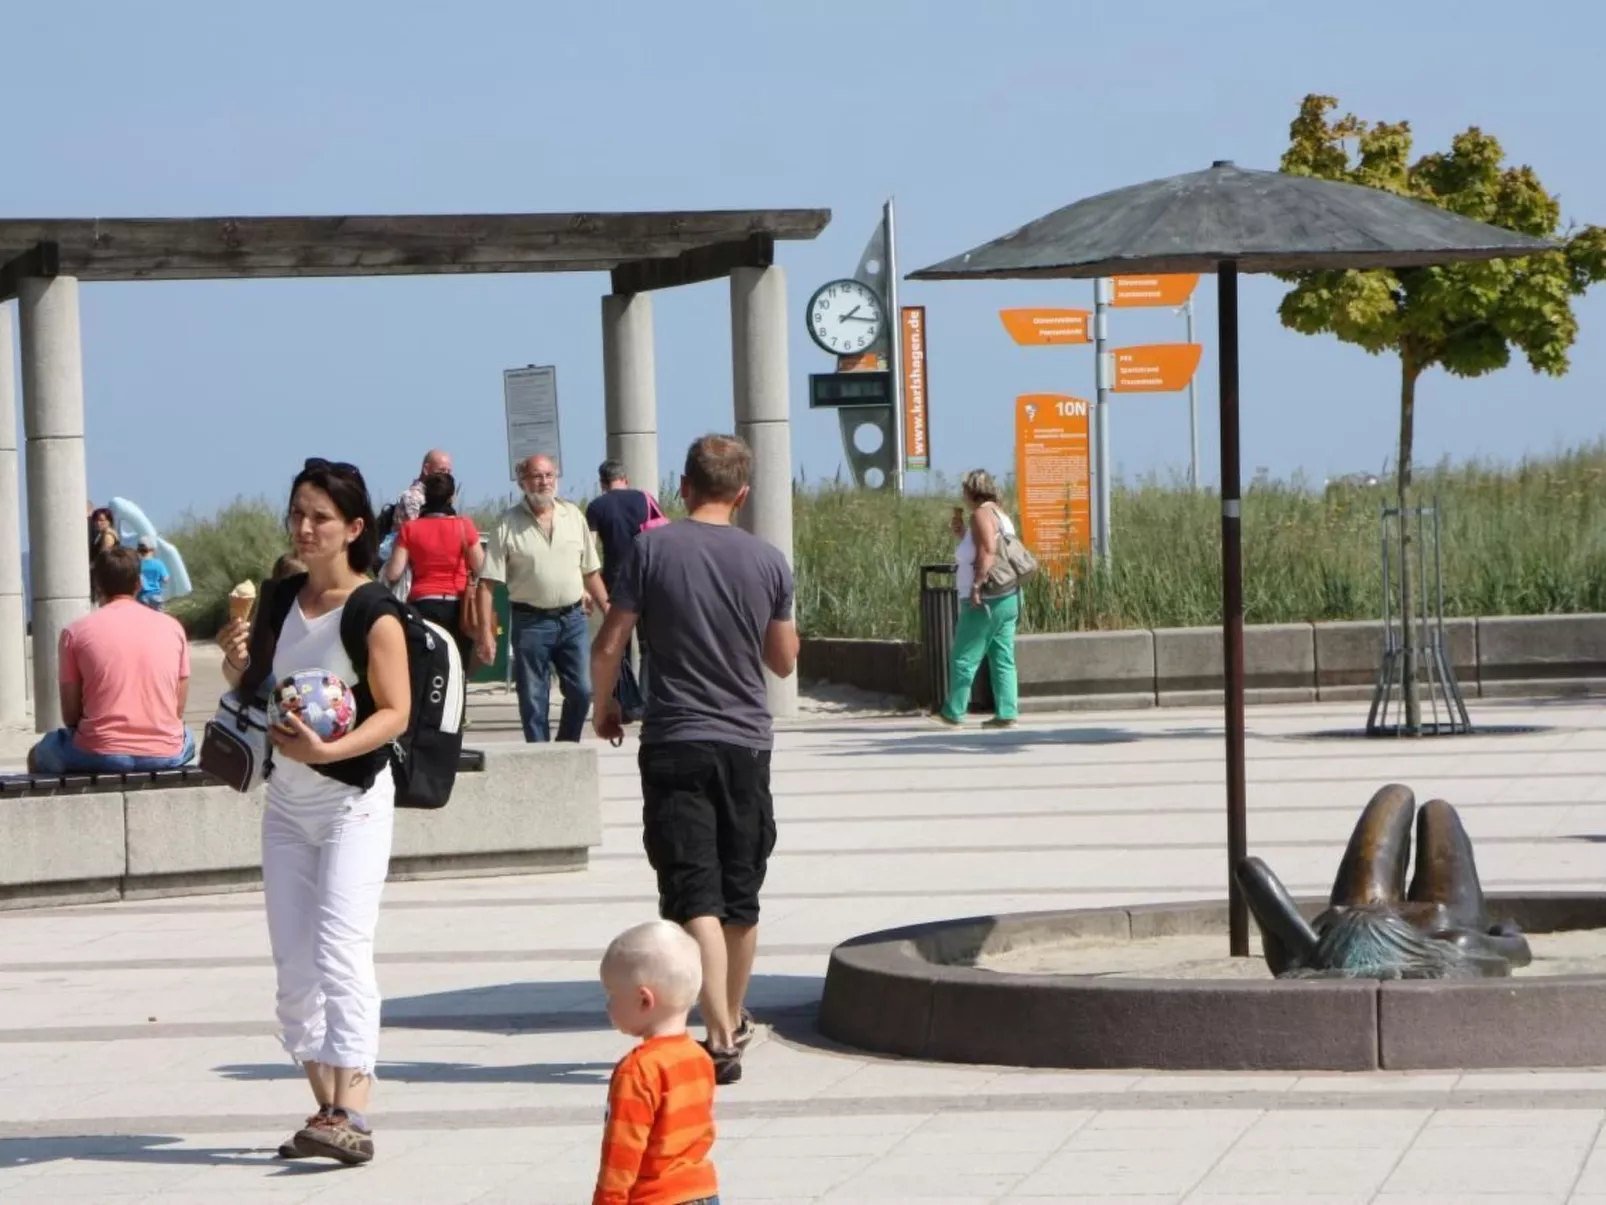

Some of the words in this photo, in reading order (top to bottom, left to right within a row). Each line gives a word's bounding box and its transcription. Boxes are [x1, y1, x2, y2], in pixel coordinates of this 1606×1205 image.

[828, 288, 836, 298] 11
[840, 283, 851, 293] 12
[818, 299, 830, 310] 10
[867, 297, 875, 307] 2
[814, 313, 822, 323] 9
[819, 327, 827, 337] 8
[867, 326, 875, 335] 4
[831, 337, 838, 347] 7
[844, 340, 852, 350] 6
[857, 336, 865, 346] 5
[907, 310, 925, 455] www.karlshagen.de
[1055, 401, 1087, 417] 10N
